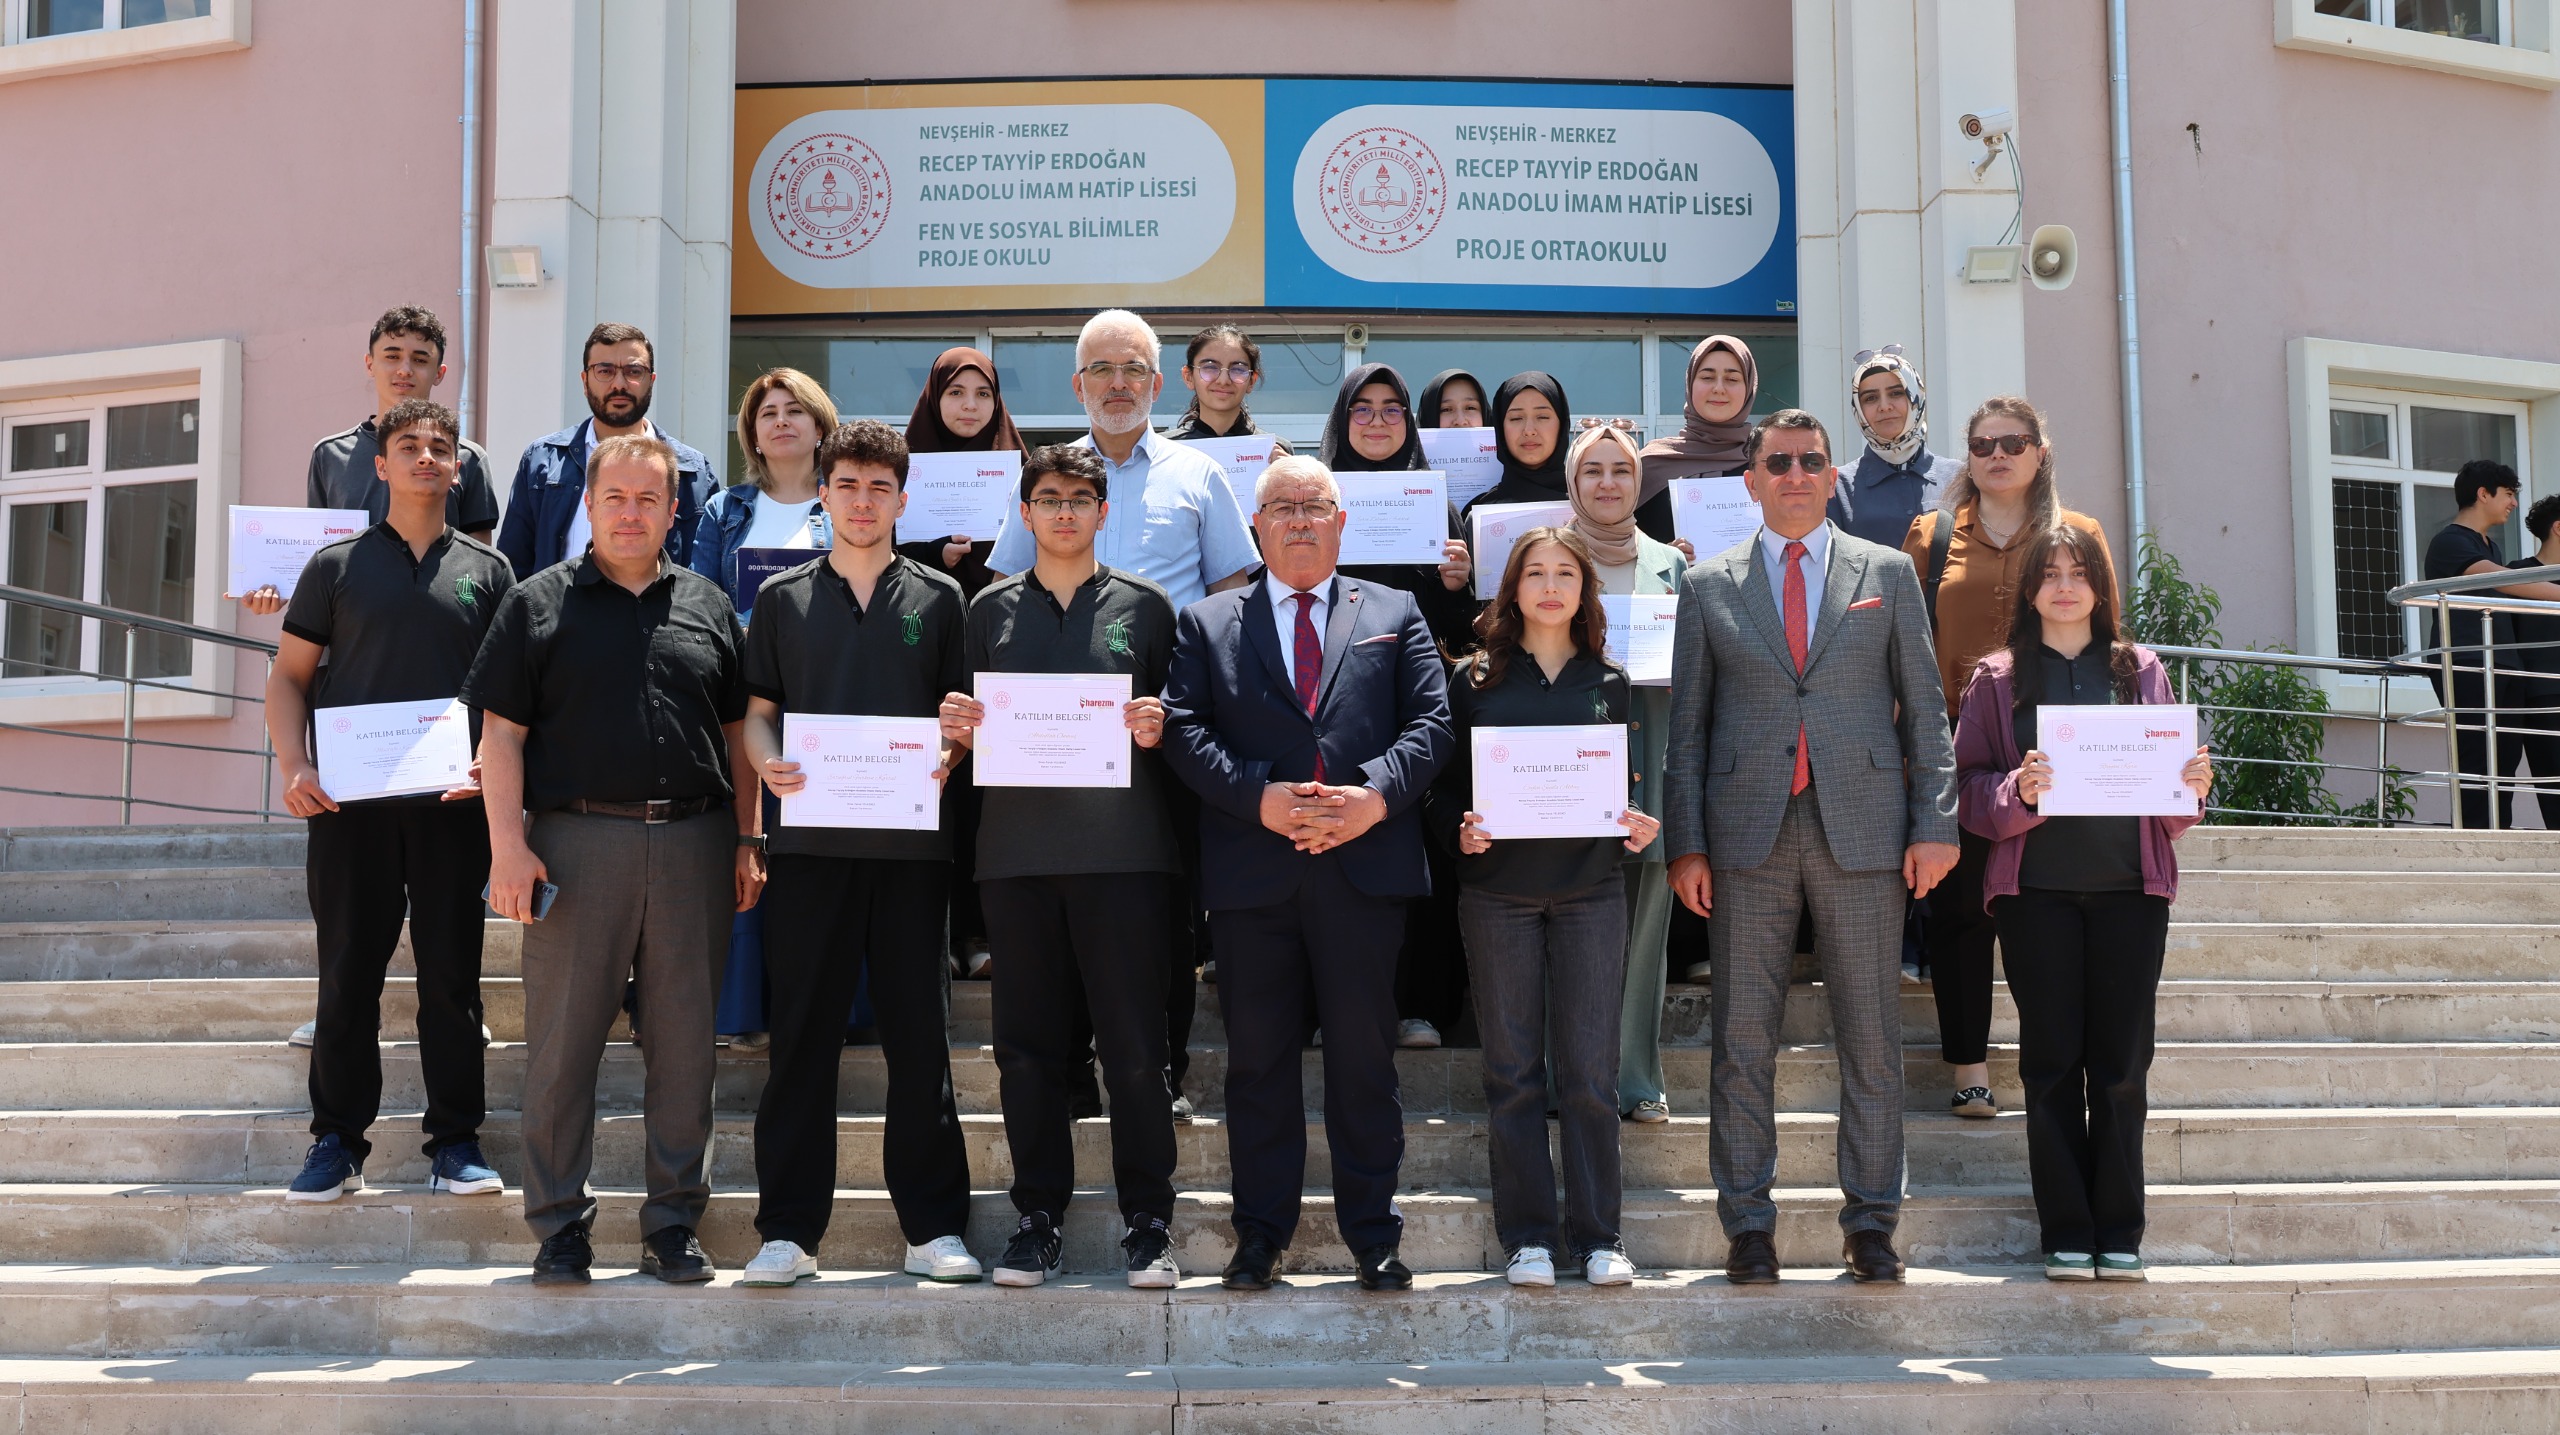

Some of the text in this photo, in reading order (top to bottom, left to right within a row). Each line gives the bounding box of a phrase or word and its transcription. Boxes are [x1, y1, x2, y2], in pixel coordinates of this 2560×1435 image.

[920, 122, 994, 142] NEVŞEHİR
[1008, 123, 1068, 137] MERKEZ
[1456, 123, 1536, 145] NEVŞEHİR
[1551, 127, 1616, 143] MERKEZ
[920, 148, 1145, 172] RECEP TAYYİP ERDOĞAN
[1456, 156, 1698, 181] RECEP TAYYİP ERDOĞAN
[790, 157, 825, 206] CUMHURİYETİ
[850, 164, 869, 192] EĞİTİM
[1343, 150, 1378, 199] CUMHURİYETİ
[1404, 160, 1423, 187] EĞİTİM
[920, 177, 1196, 201] ANADOLU İMAM HATİP LİSESİ
[838, 194, 869, 234] BAKANLIĞI
[1457, 190, 1752, 216] ANADOLU İMAM HATİP LİSESİ
[791, 208, 821, 235] TÜRKİYE
[1345, 201, 1374, 229] TÜRKİYE
[919, 217, 1158, 240] FEN VE SOSYAL BİLİMLER
[919, 248, 1050, 267] PROJE OKULU
[1457, 239, 1666, 263] PROJE ORTAOKULU
[1223, 466, 1247, 474] LGESİ
[1384, 499, 1415, 507] BELGESİ
[265, 538, 301, 546] KATILIM
[1014, 712, 1092, 721] KATILIM BELGESİ
[356, 725, 431, 740] KATILIM BELGESİ
[2079, 743, 2157, 752] KATILIM BELGESİ
[823, 755, 901, 764] KATILIM BELGESİ
[1513, 764, 1589, 773] KATILIM BELGESİ
